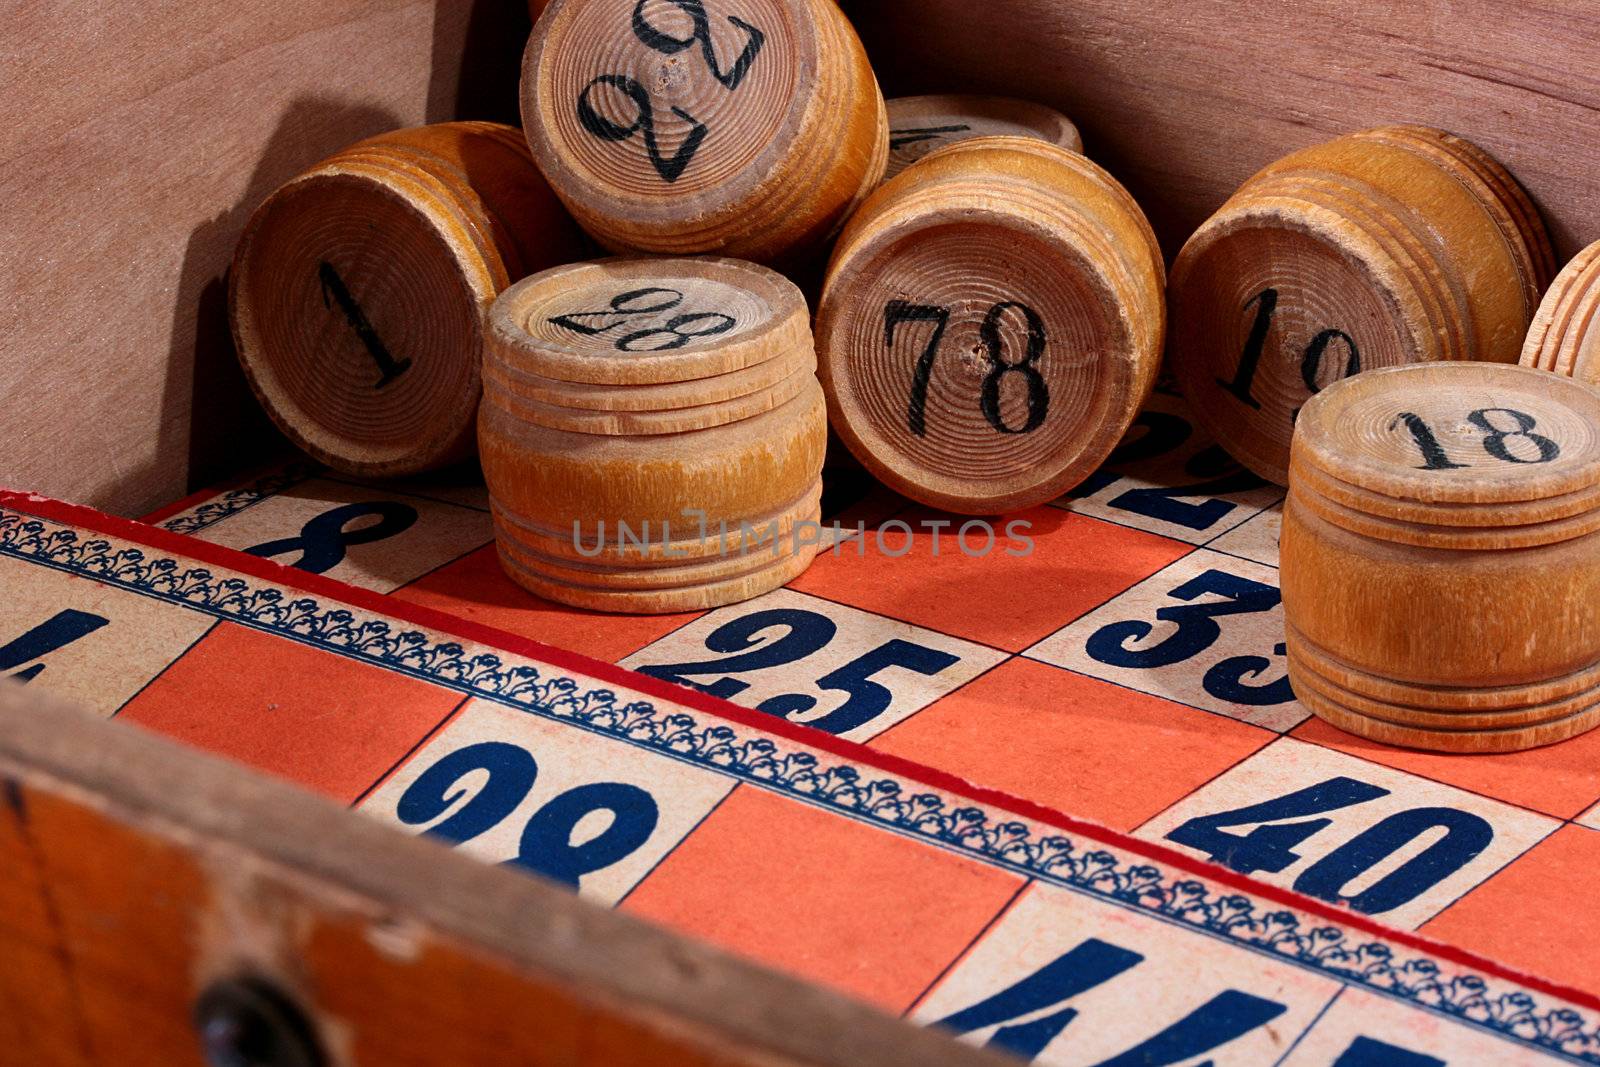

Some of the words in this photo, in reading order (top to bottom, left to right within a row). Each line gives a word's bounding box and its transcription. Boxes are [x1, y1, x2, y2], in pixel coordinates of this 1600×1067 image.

[884, 299, 1050, 438] 78
[1388, 407, 1561, 471] 18
[636, 607, 962, 735] 25
[1167, 775, 1494, 916] 40
